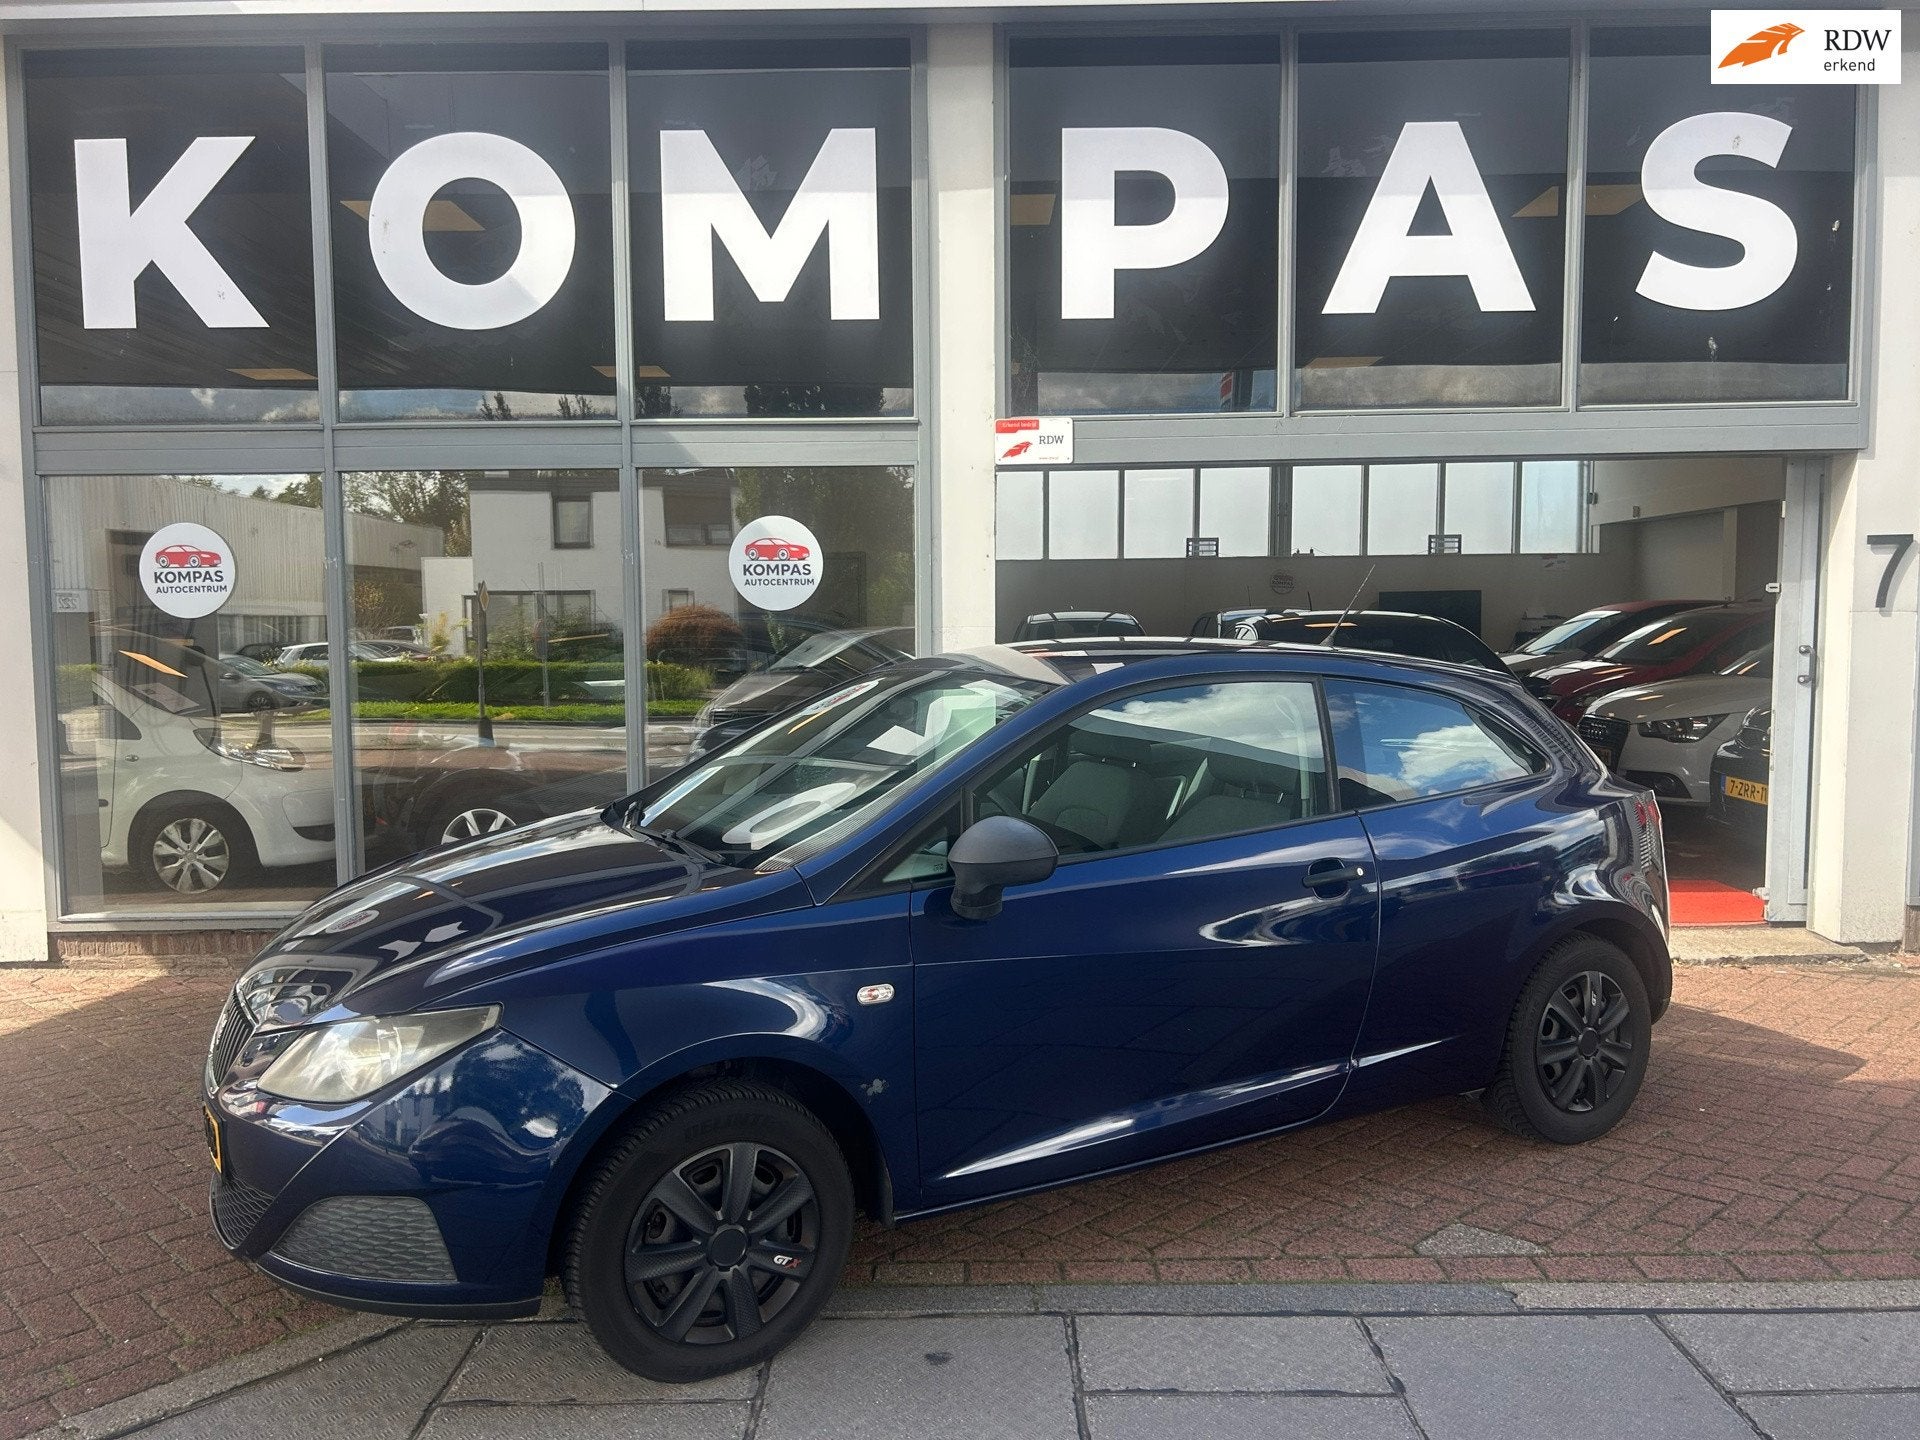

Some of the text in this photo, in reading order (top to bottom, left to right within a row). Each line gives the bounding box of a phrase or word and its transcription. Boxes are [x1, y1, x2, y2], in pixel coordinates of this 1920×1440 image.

[1038, 435, 1064, 445] RDW
[742, 563, 812, 576] KOMPAS
[1866, 533, 1914, 608] 7
[153, 570, 224, 583] KOMPAS
[744, 578, 815, 586] AUTOCENTRUM
[155, 585, 228, 594] AUTOCENTRUM
[773, 1254, 801, 1269] GTX
